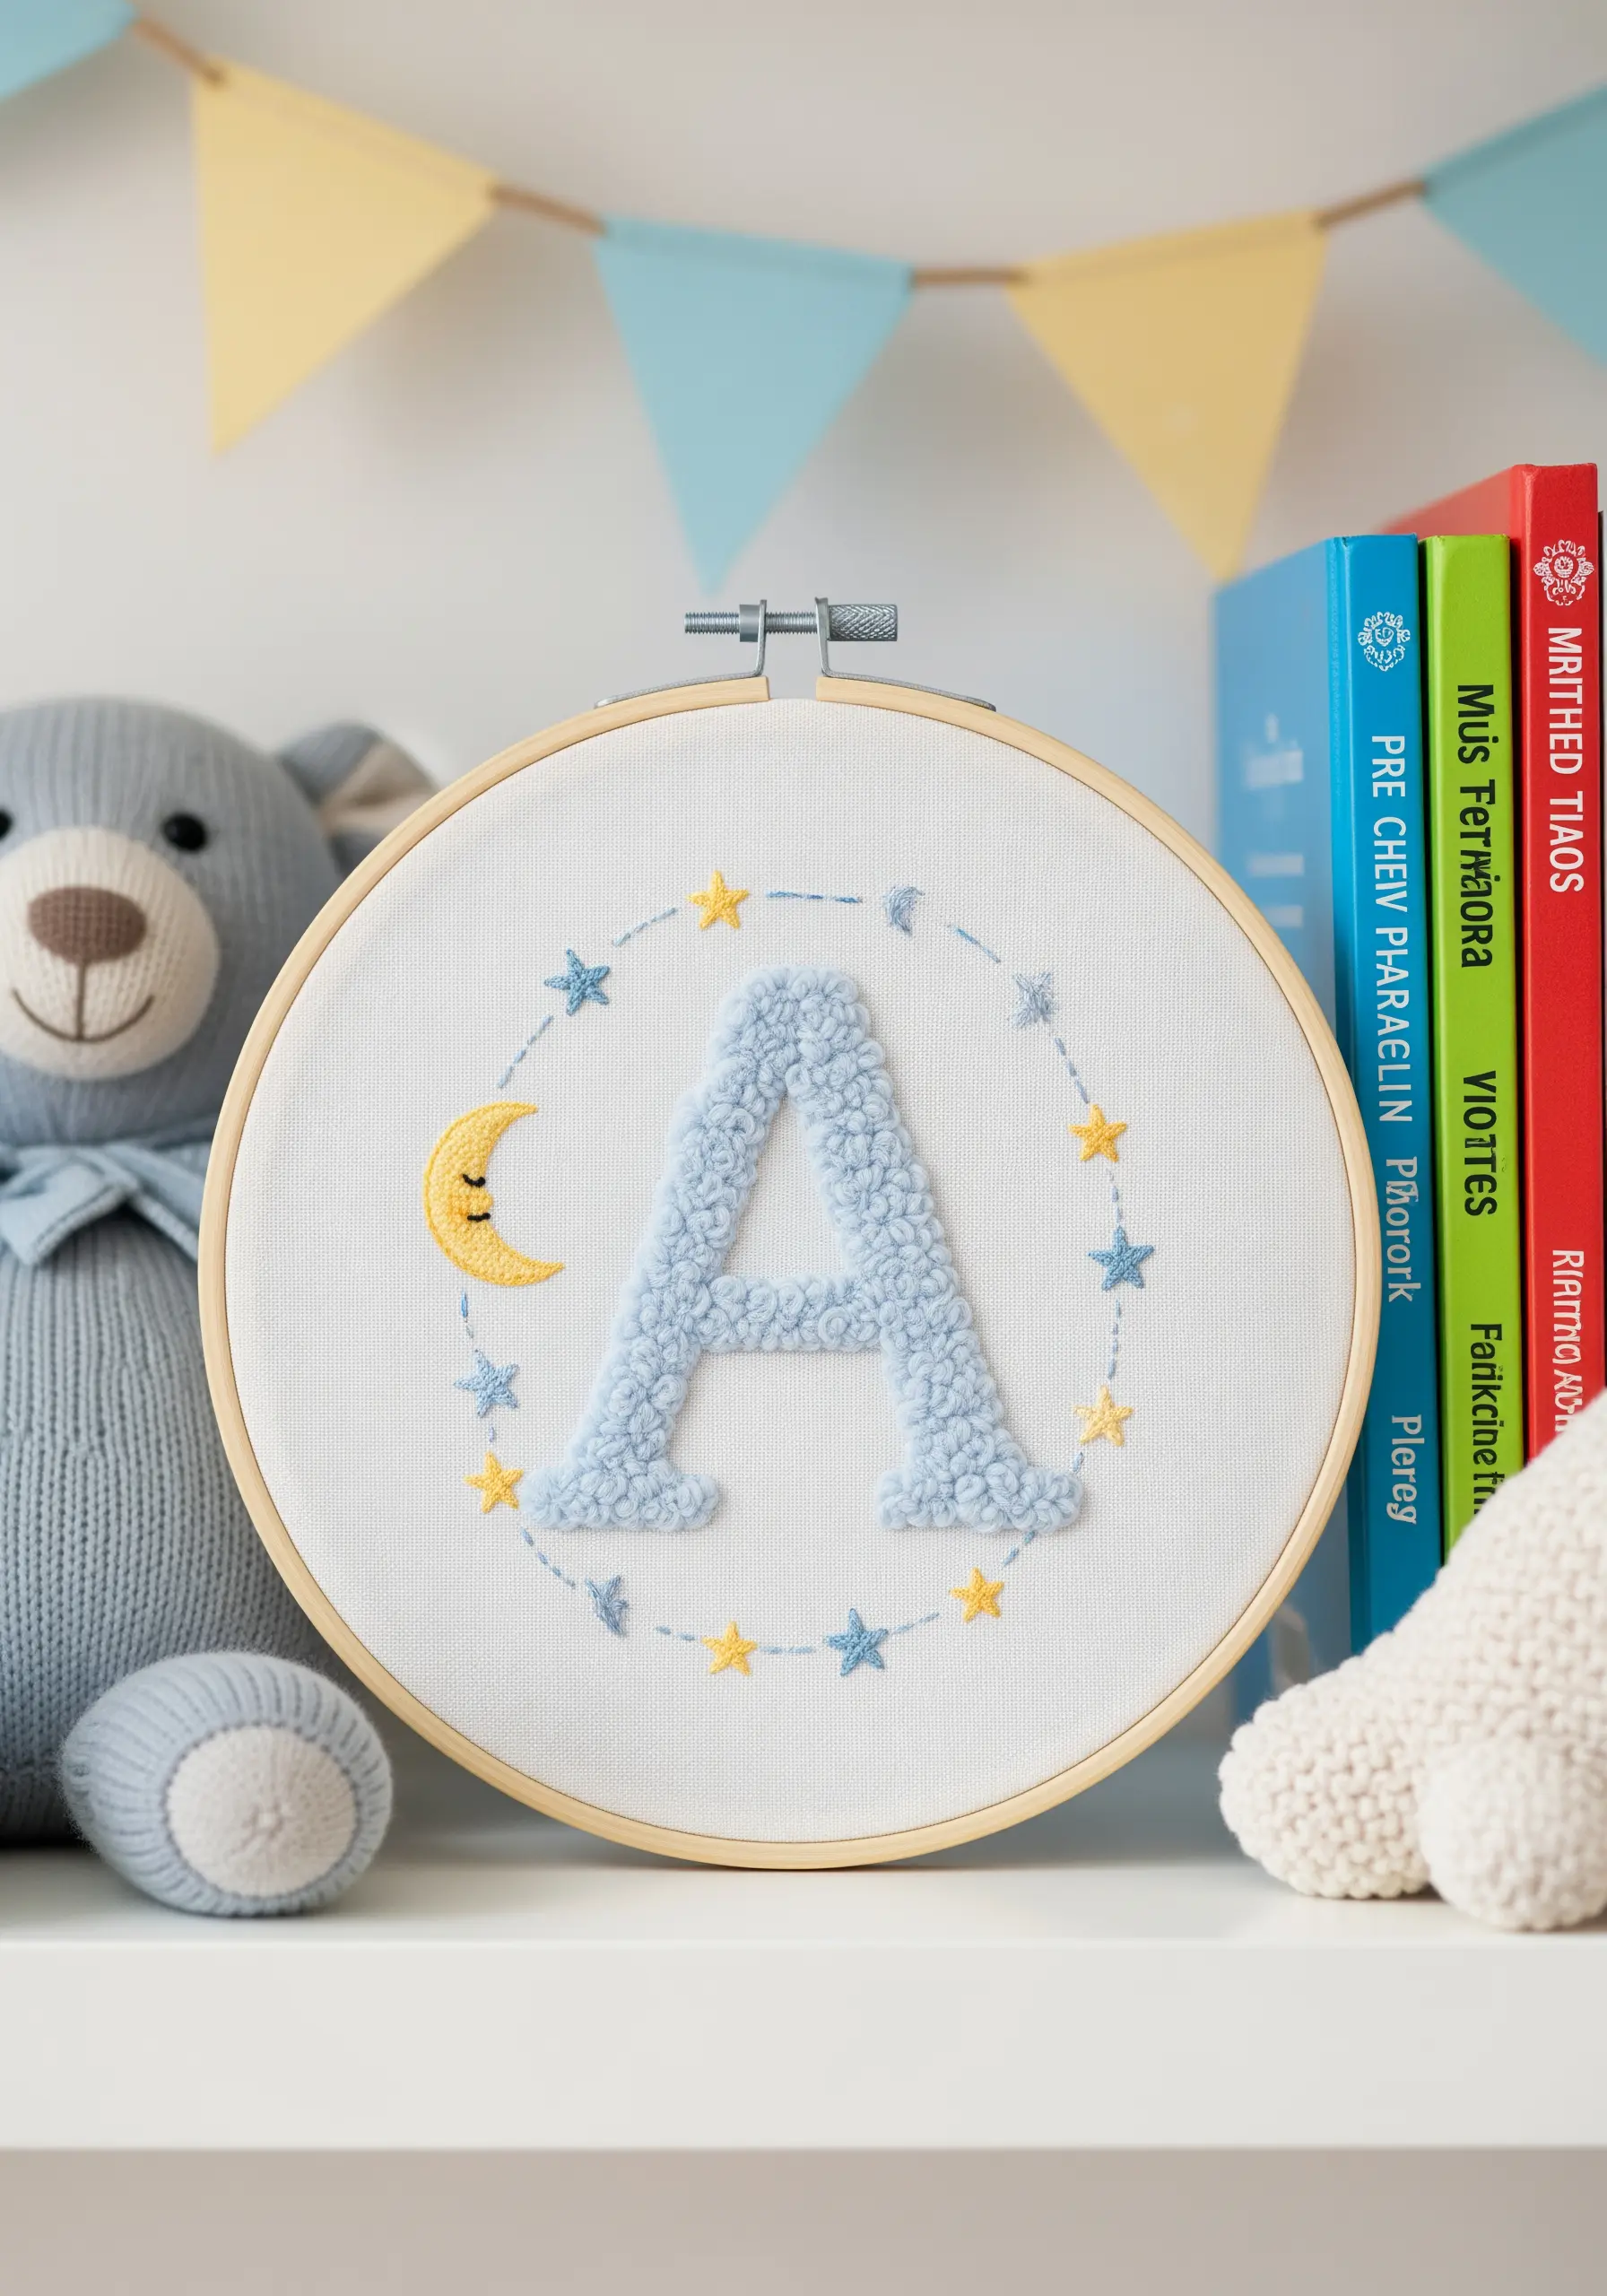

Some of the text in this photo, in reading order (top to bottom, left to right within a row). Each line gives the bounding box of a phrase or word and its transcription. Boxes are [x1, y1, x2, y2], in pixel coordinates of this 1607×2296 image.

[1371, 735, 1405, 798] PRE
[1548, 627, 1585, 892] MRITHED TIAOS
[519, 964, 1083, 1533] A
